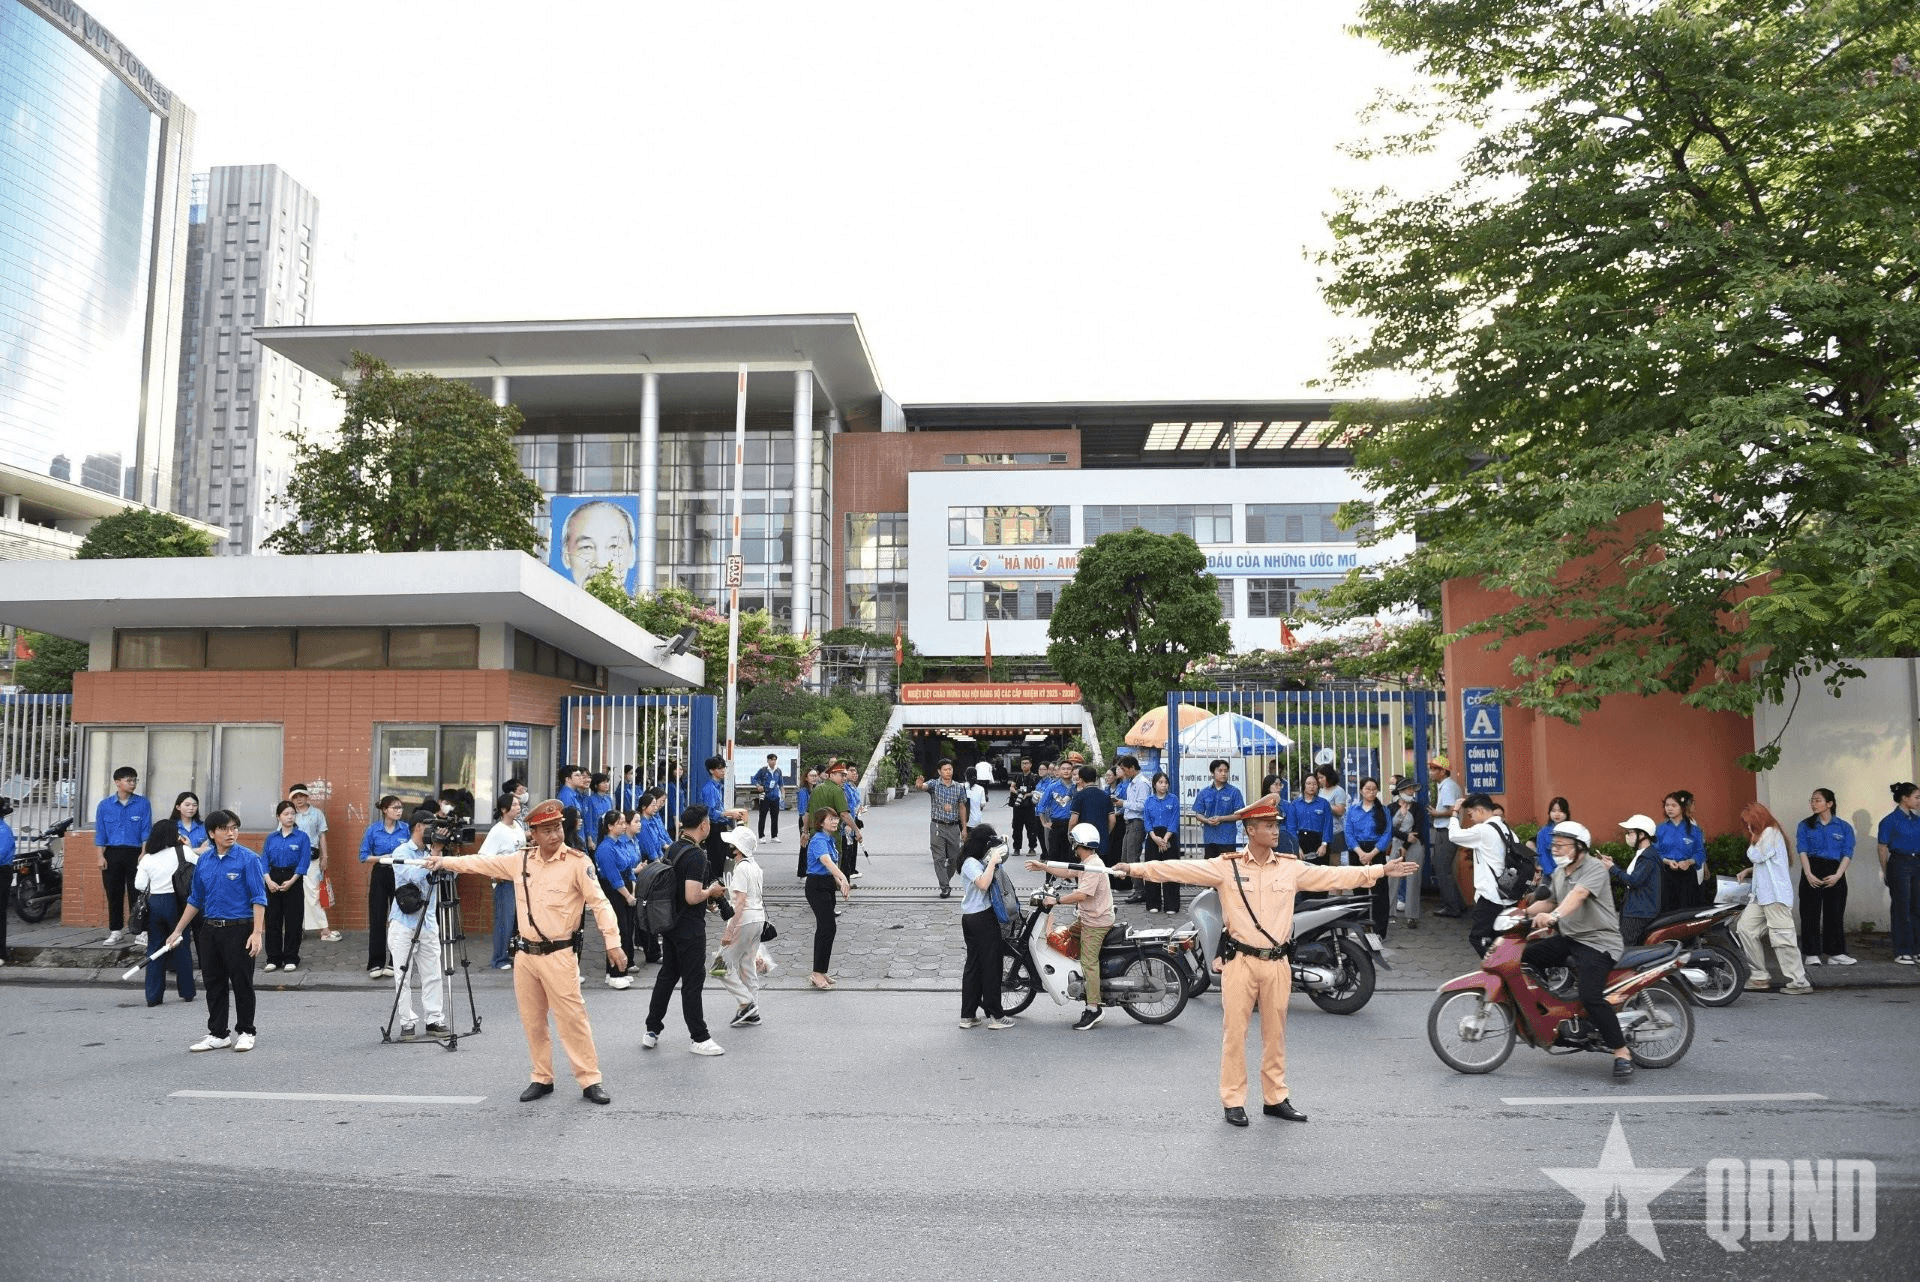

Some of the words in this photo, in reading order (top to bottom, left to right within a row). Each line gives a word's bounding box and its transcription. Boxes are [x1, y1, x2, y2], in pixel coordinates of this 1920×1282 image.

[117, 43, 170, 111] TOWER
[1024, 554, 1045, 573] NỘI
[1236, 550, 1261, 568] CỦA
[1264, 552, 1306, 568] NHỮNG
[1309, 552, 1334, 568] ƯỚC
[1337, 553, 1357, 567] MƠ
[728, 558, 740, 583] STOP
[1470, 709, 1496, 735] A
[1468, 746, 1485, 758] CỔNG
[1487, 748, 1499, 758] VÀO
[1471, 763, 1483, 773] CHO
[1473, 778, 1481, 787] XE
[1482, 776, 1497, 787] MÁY
